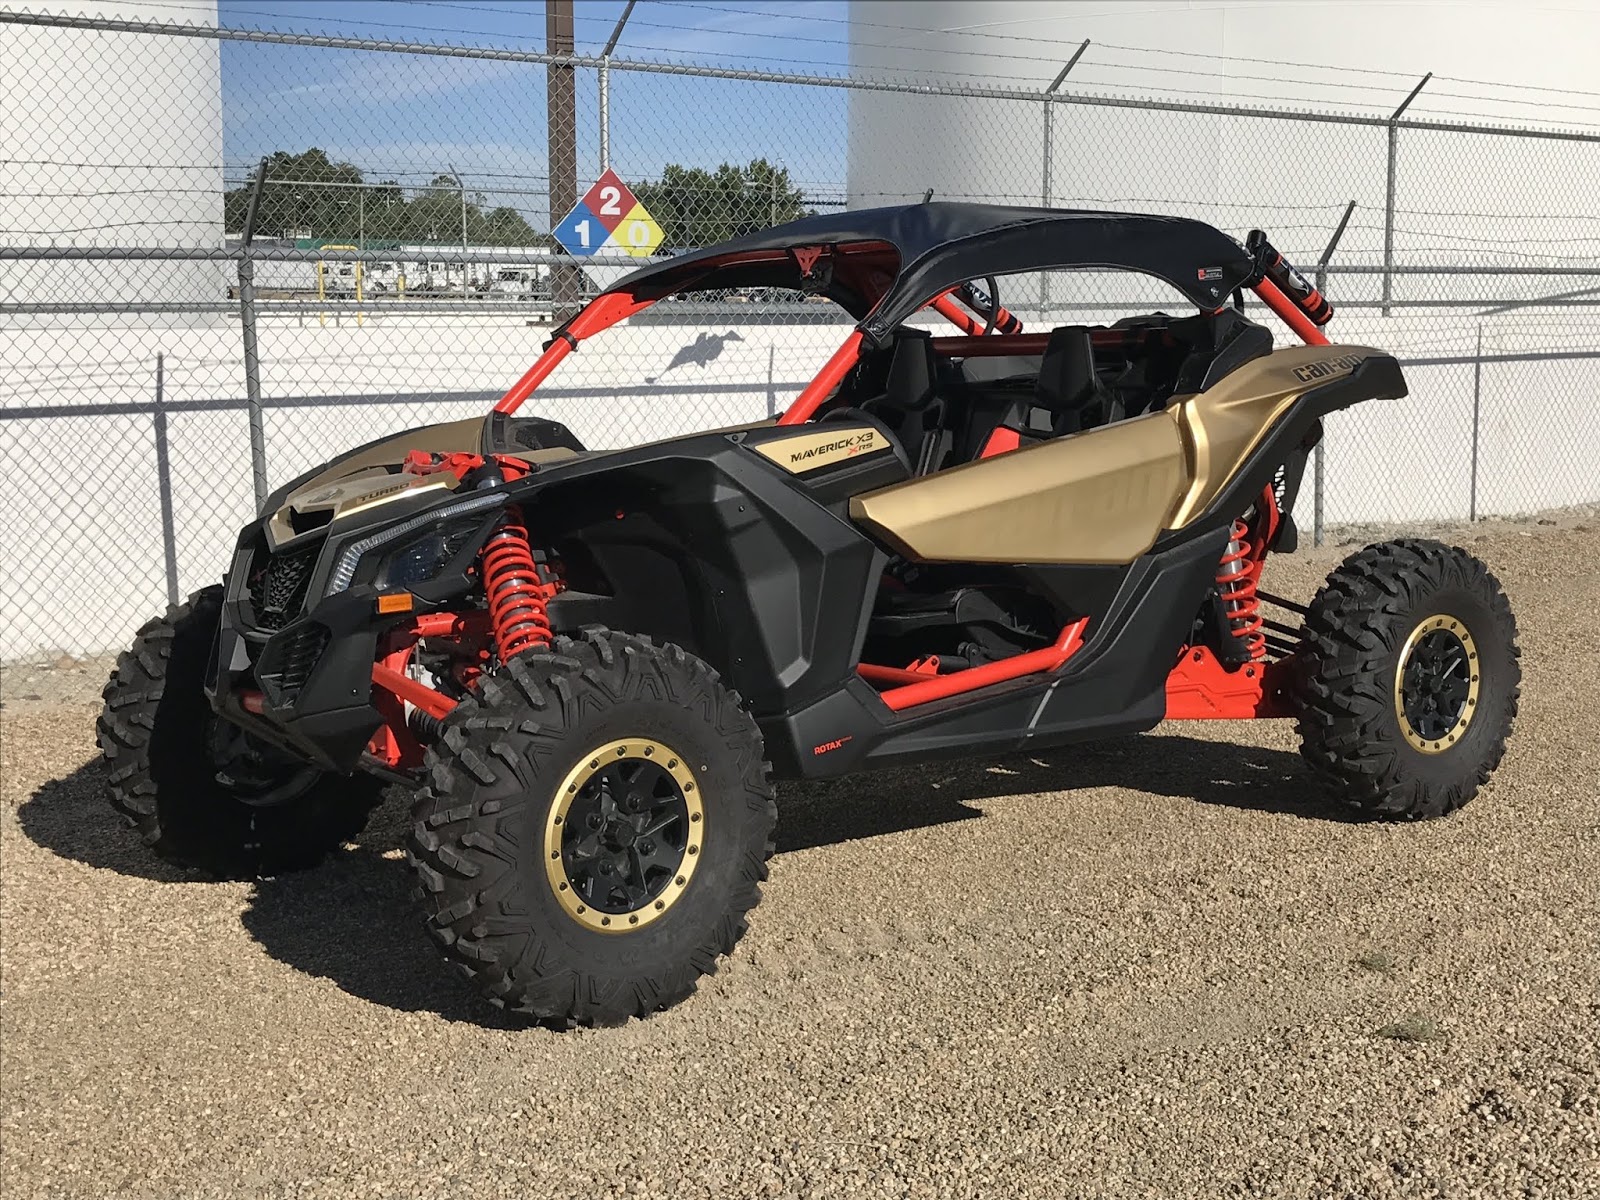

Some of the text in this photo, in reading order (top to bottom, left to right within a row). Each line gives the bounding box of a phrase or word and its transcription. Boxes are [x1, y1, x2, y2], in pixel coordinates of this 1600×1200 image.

[599, 186, 621, 215] 2
[574, 219, 590, 249] 1
[627, 221, 650, 249] 0
[790, 431, 874, 463] MAVERICK X3
[360, 482, 410, 502] TURBO
[814, 739, 842, 755] ROTAX
